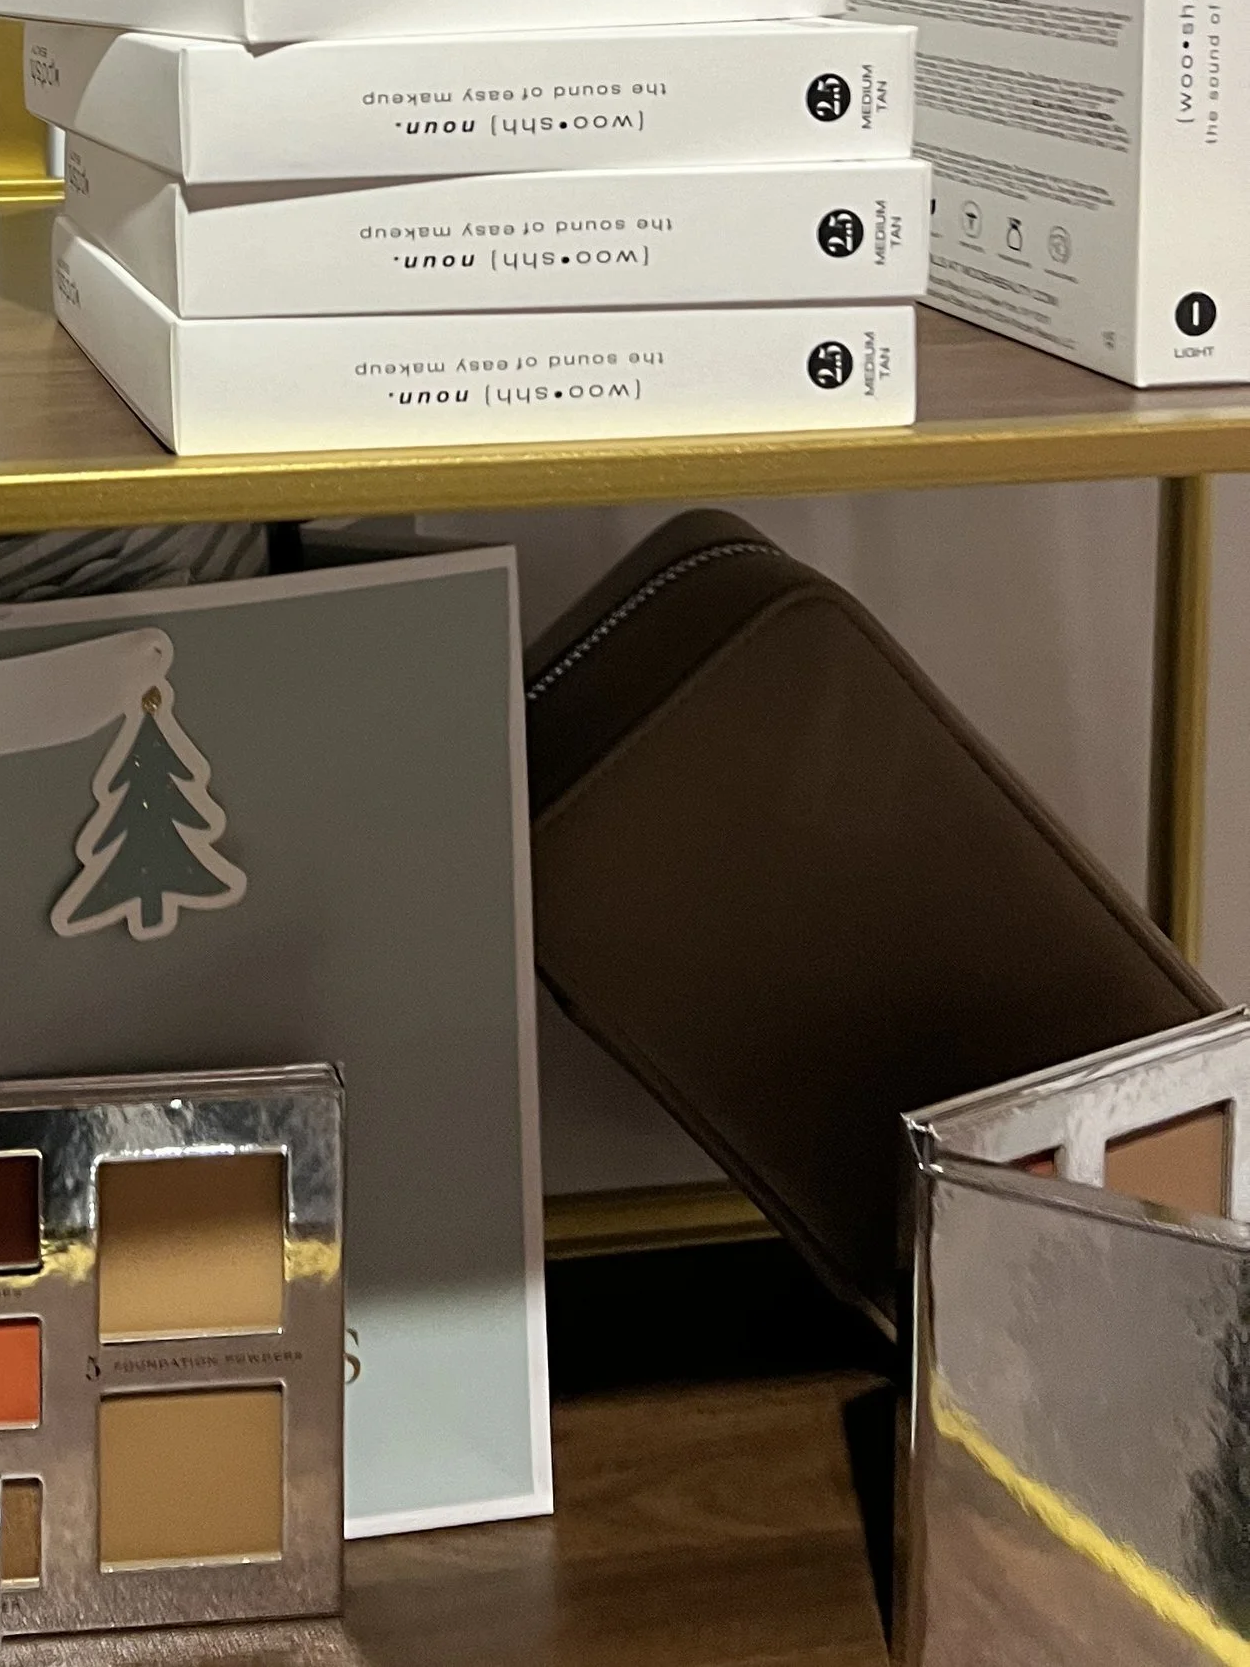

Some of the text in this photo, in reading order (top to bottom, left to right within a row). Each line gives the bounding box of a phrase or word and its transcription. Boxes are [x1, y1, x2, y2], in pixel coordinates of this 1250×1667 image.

[362, 82, 668, 106] the sound of easy makeup
[861, 64, 873, 130] MEDIUM
[876, 80, 888, 111] TAN
[395, 118, 476, 135] noun.
[359, 218, 673, 241] the sound of easy makeup
[874, 199, 887, 266] MEDIUM
[890, 215, 902, 248] TAN
[393, 253, 476, 269] noun.
[354, 351, 664, 376] the sound of easy makeup
[863, 331, 876, 397] MEDIUM
[879, 346, 890, 378] TAN
[388, 388, 469, 405] noun.
